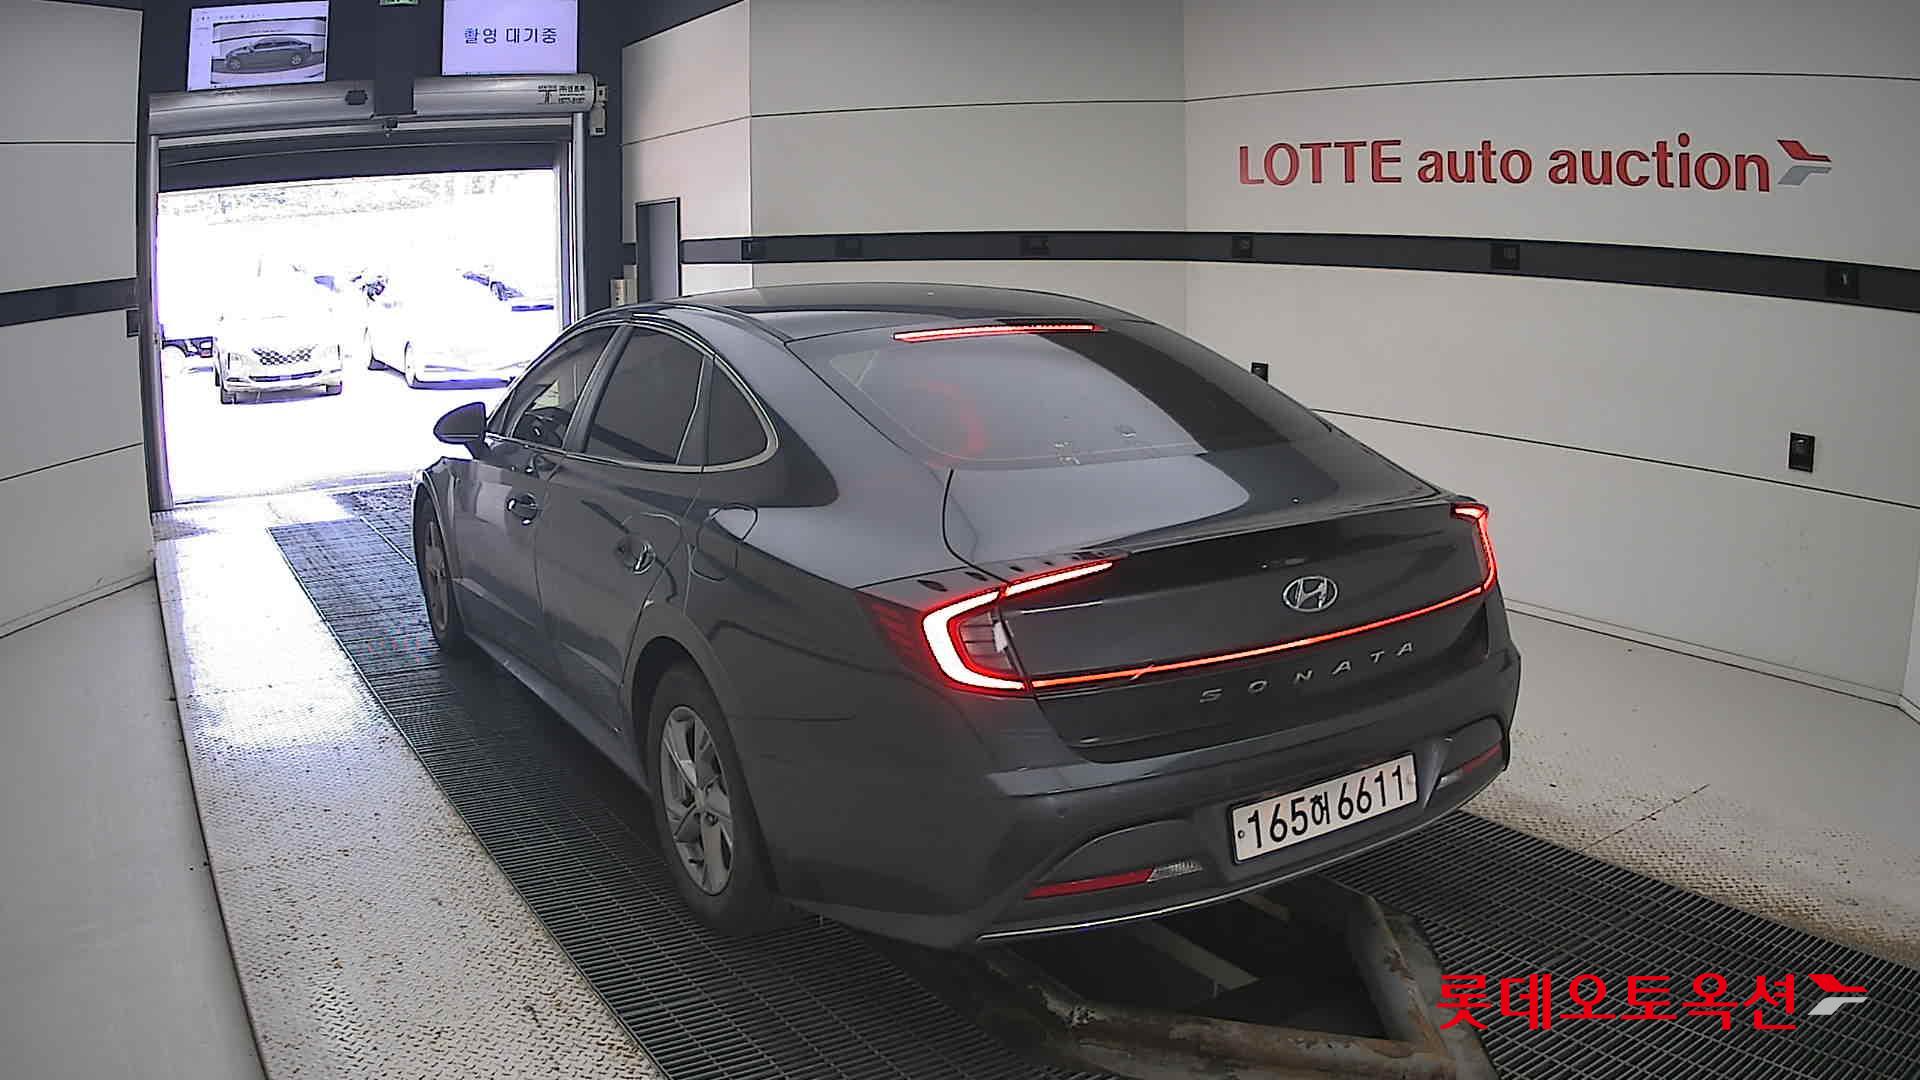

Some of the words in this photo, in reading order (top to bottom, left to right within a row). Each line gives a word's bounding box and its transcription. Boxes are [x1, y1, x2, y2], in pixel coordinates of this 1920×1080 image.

[463, 27, 497, 44] 촬영
[505, 27, 558, 44] 대기중
[1239, 139, 1402, 186] LOTTE
[1417, 139, 1533, 185] auto
[1548, 133, 1770, 193] auction
[1198, 641, 1414, 704] SONATA
